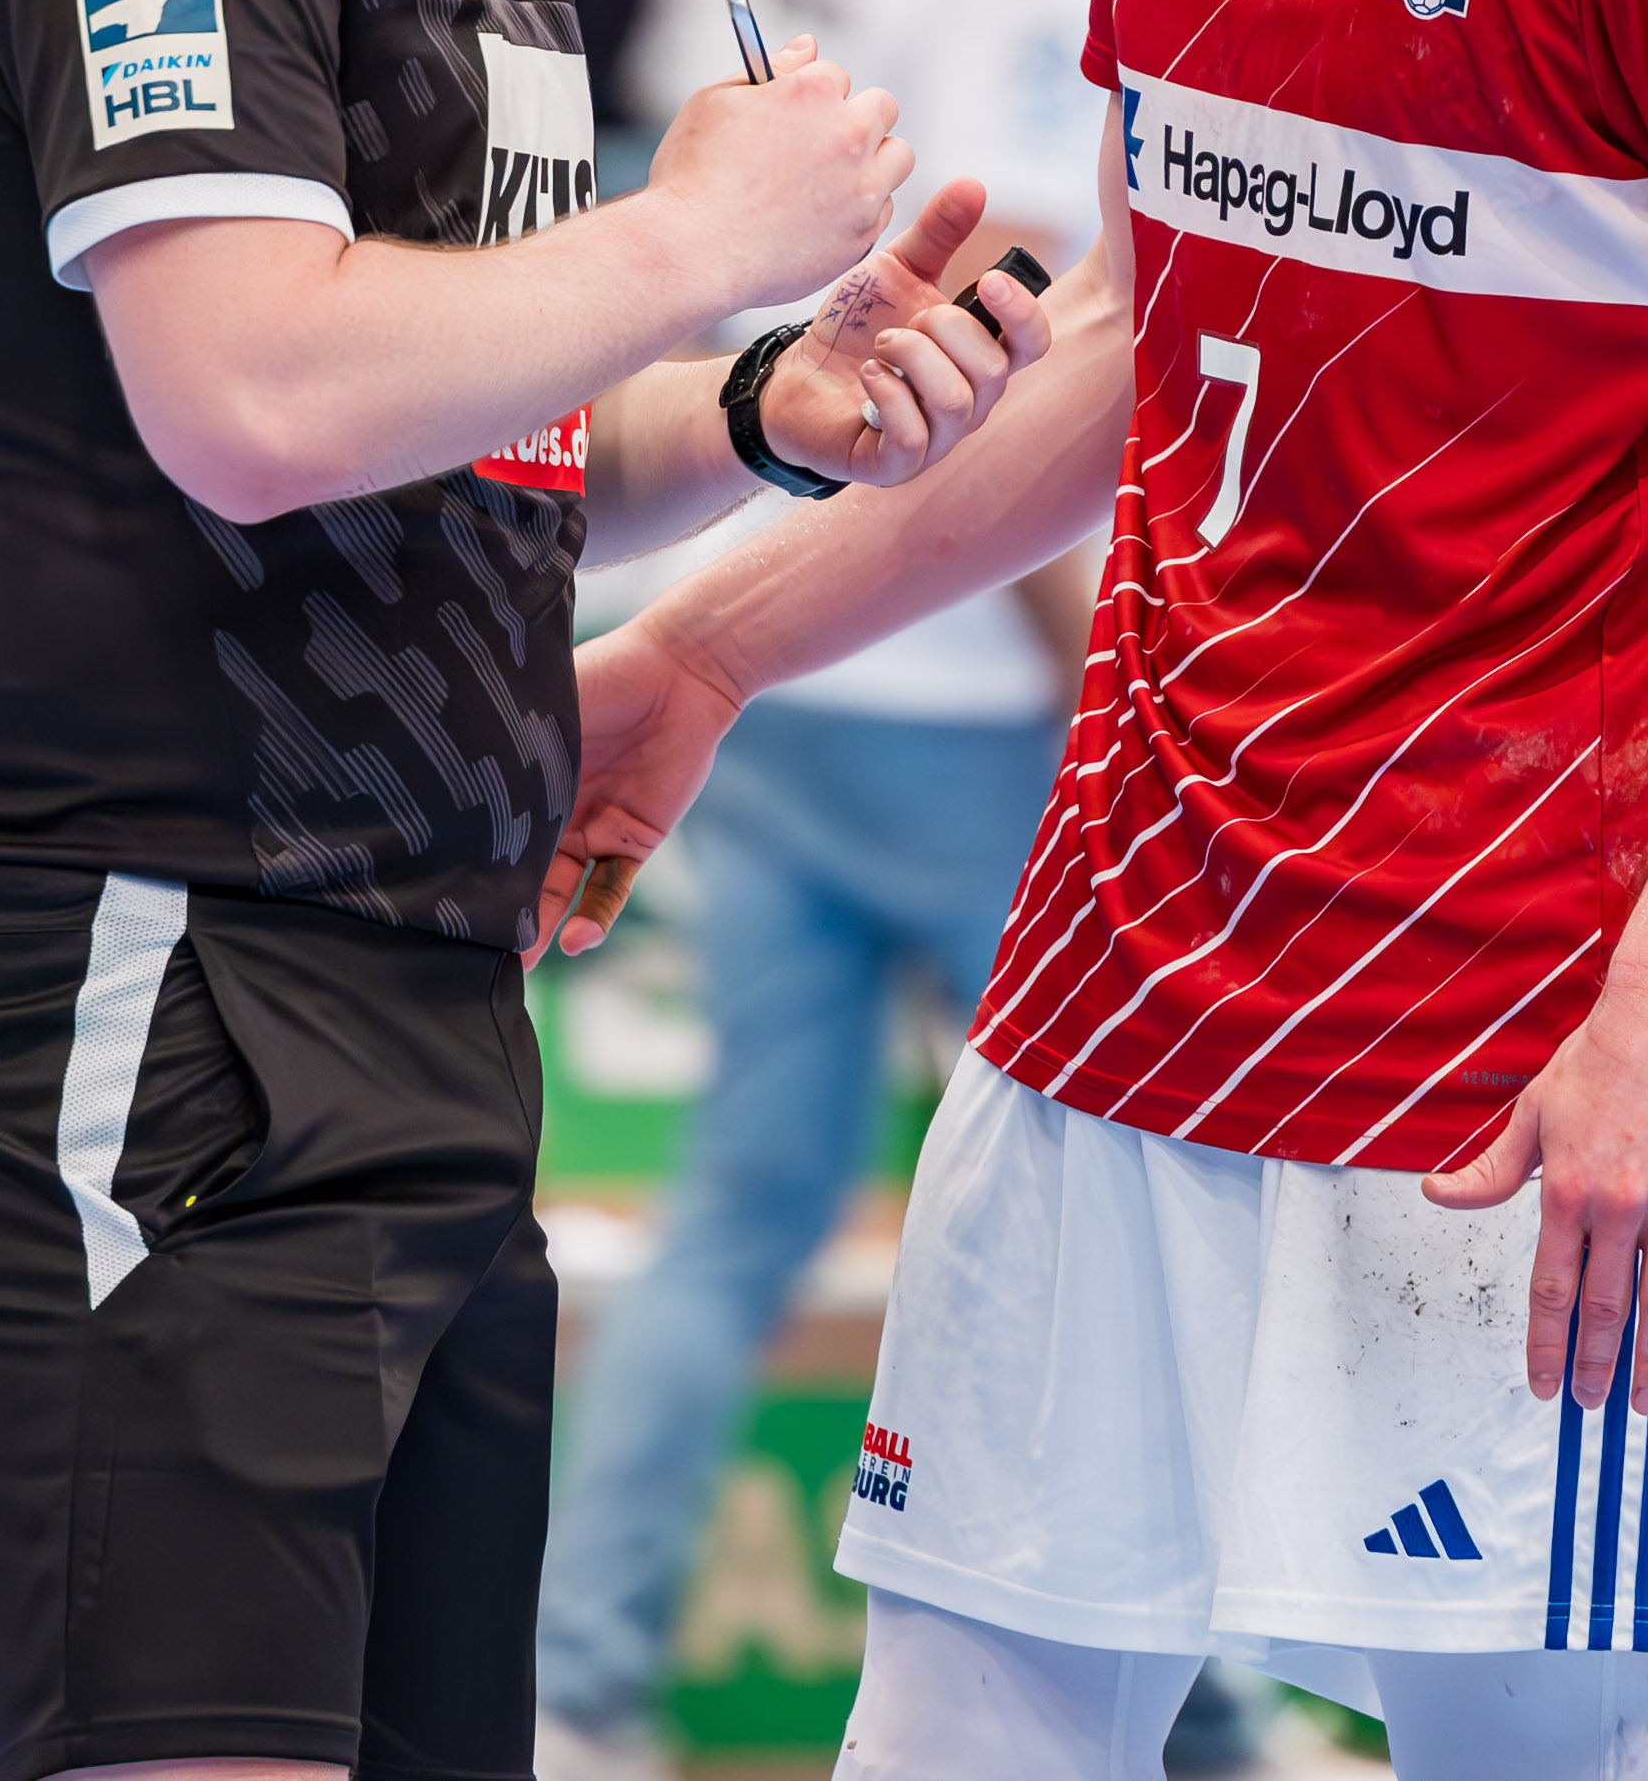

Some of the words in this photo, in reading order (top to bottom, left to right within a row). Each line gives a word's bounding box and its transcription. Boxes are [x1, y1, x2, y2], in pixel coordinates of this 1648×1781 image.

[104, 79, 217, 128] HBL
[122, 53, 212, 79] DAIKIN
[1164, 124, 1470, 260] Hapag-Lloyd
[1195, 329, 1261, 552] 7
